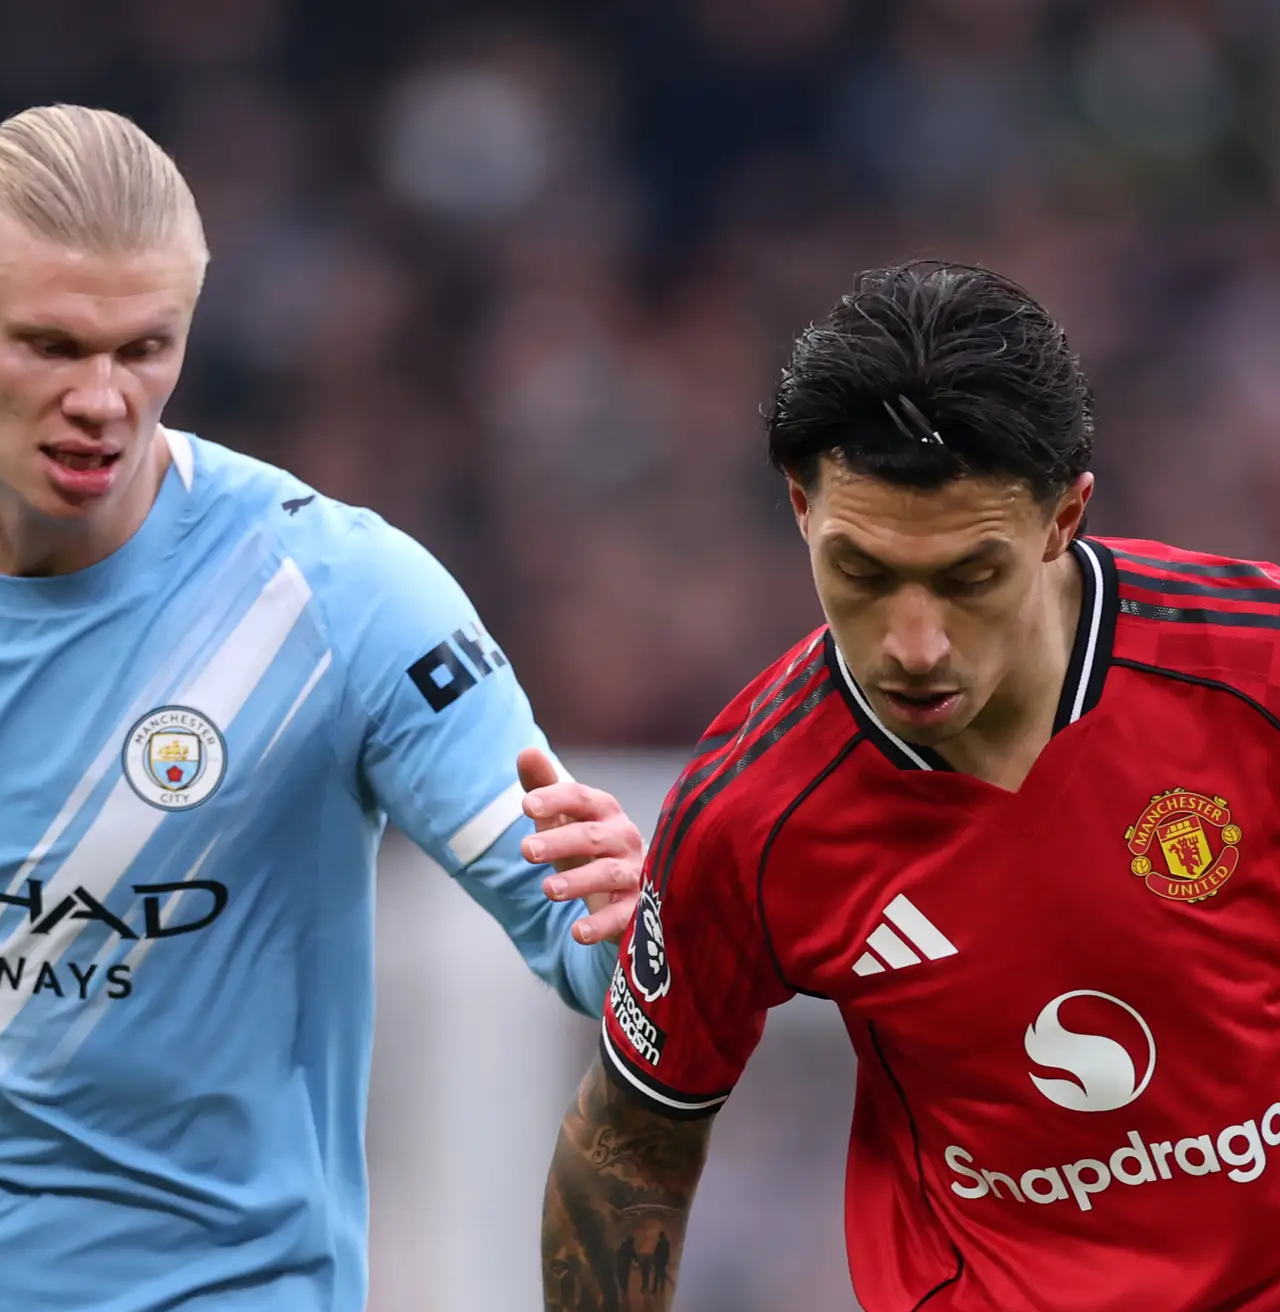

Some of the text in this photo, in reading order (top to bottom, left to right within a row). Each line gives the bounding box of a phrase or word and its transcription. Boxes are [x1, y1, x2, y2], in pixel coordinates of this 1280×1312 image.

[135, 714, 216, 745] MANCHESTER
[160, 793, 191, 804] CITY
[1135, 796, 1223, 846] MANCHESTER
[1168, 865, 1229, 896] UNITED
[616, 1003, 661, 1067] racism
[623, 989, 657, 1044] room
